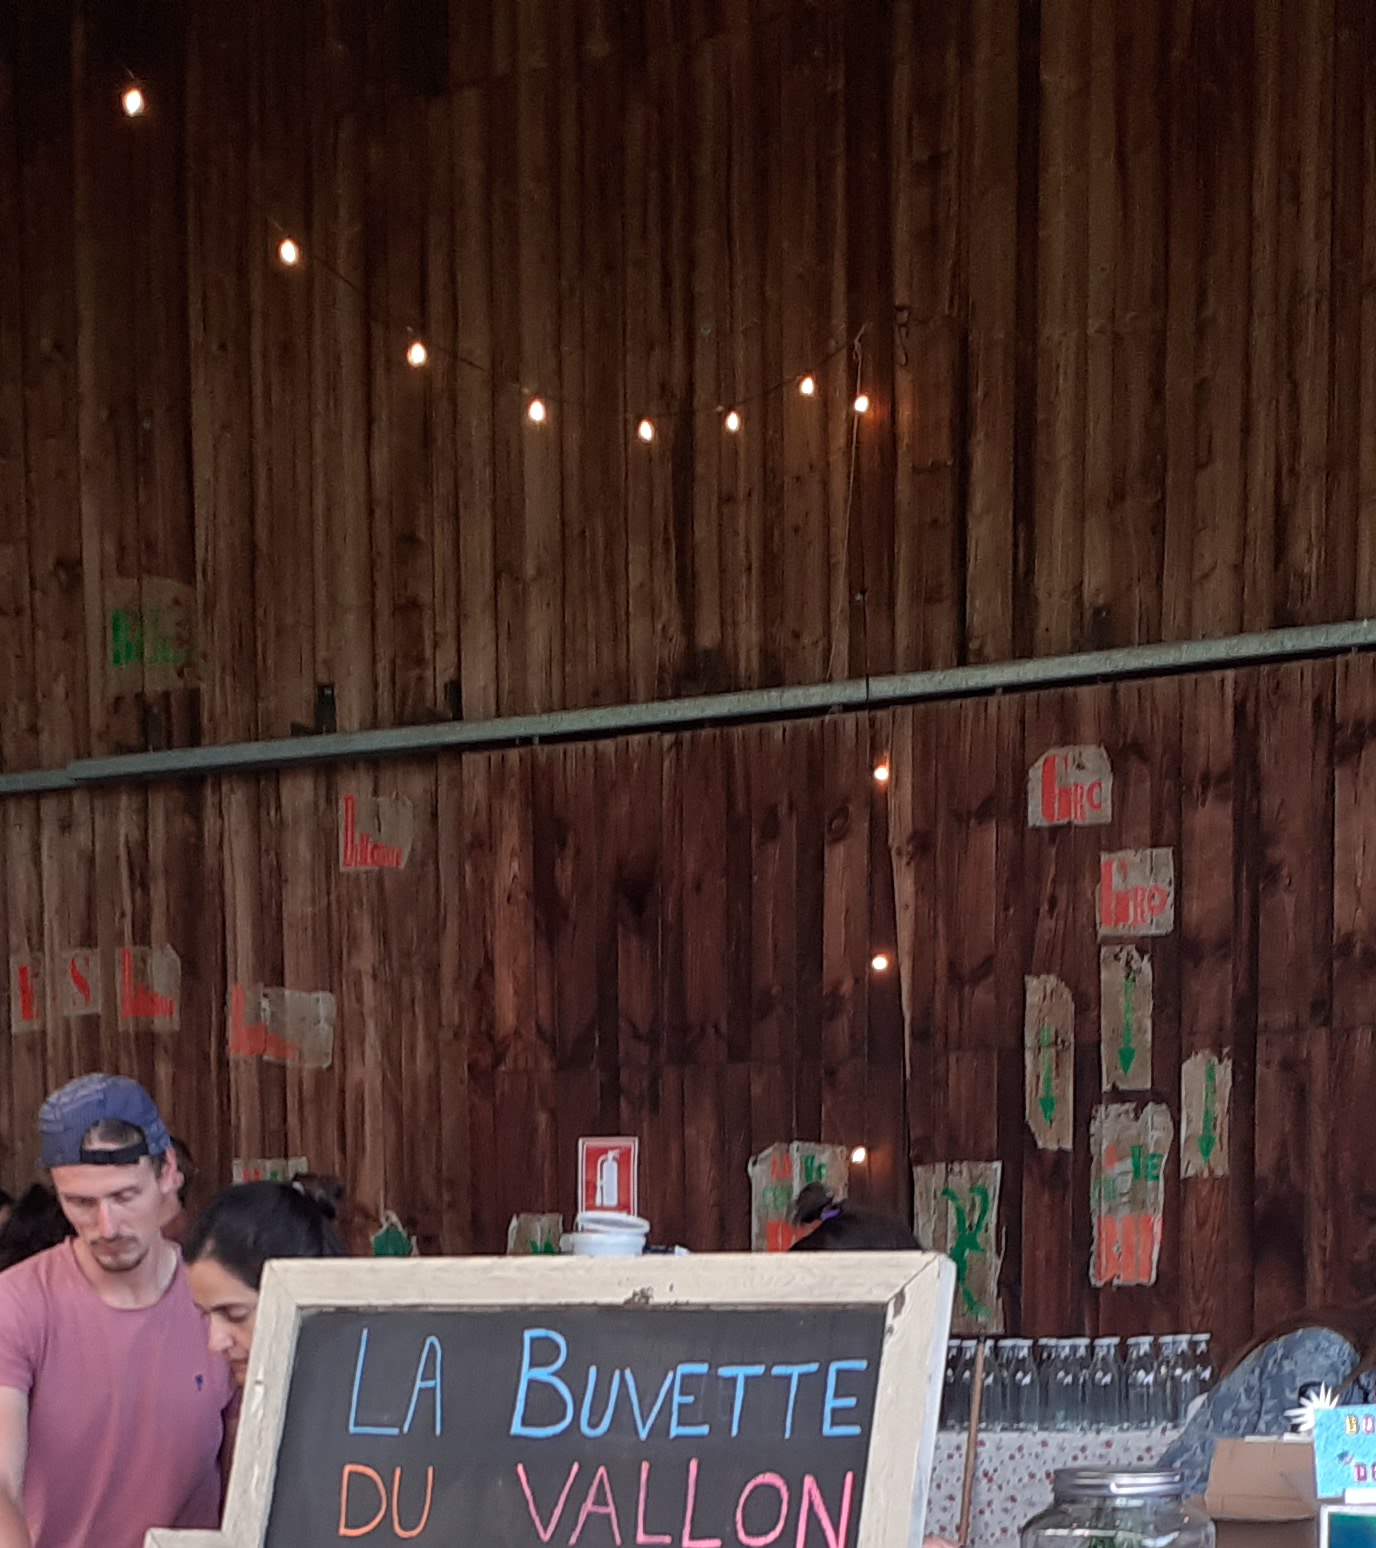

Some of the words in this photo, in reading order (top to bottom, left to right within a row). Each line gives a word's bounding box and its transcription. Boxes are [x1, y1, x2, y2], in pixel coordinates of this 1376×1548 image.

[349, 1328, 442, 1437] LA
[510, 1328, 868, 1441] BUVETTE
[338, 1463, 434, 1539] DU
